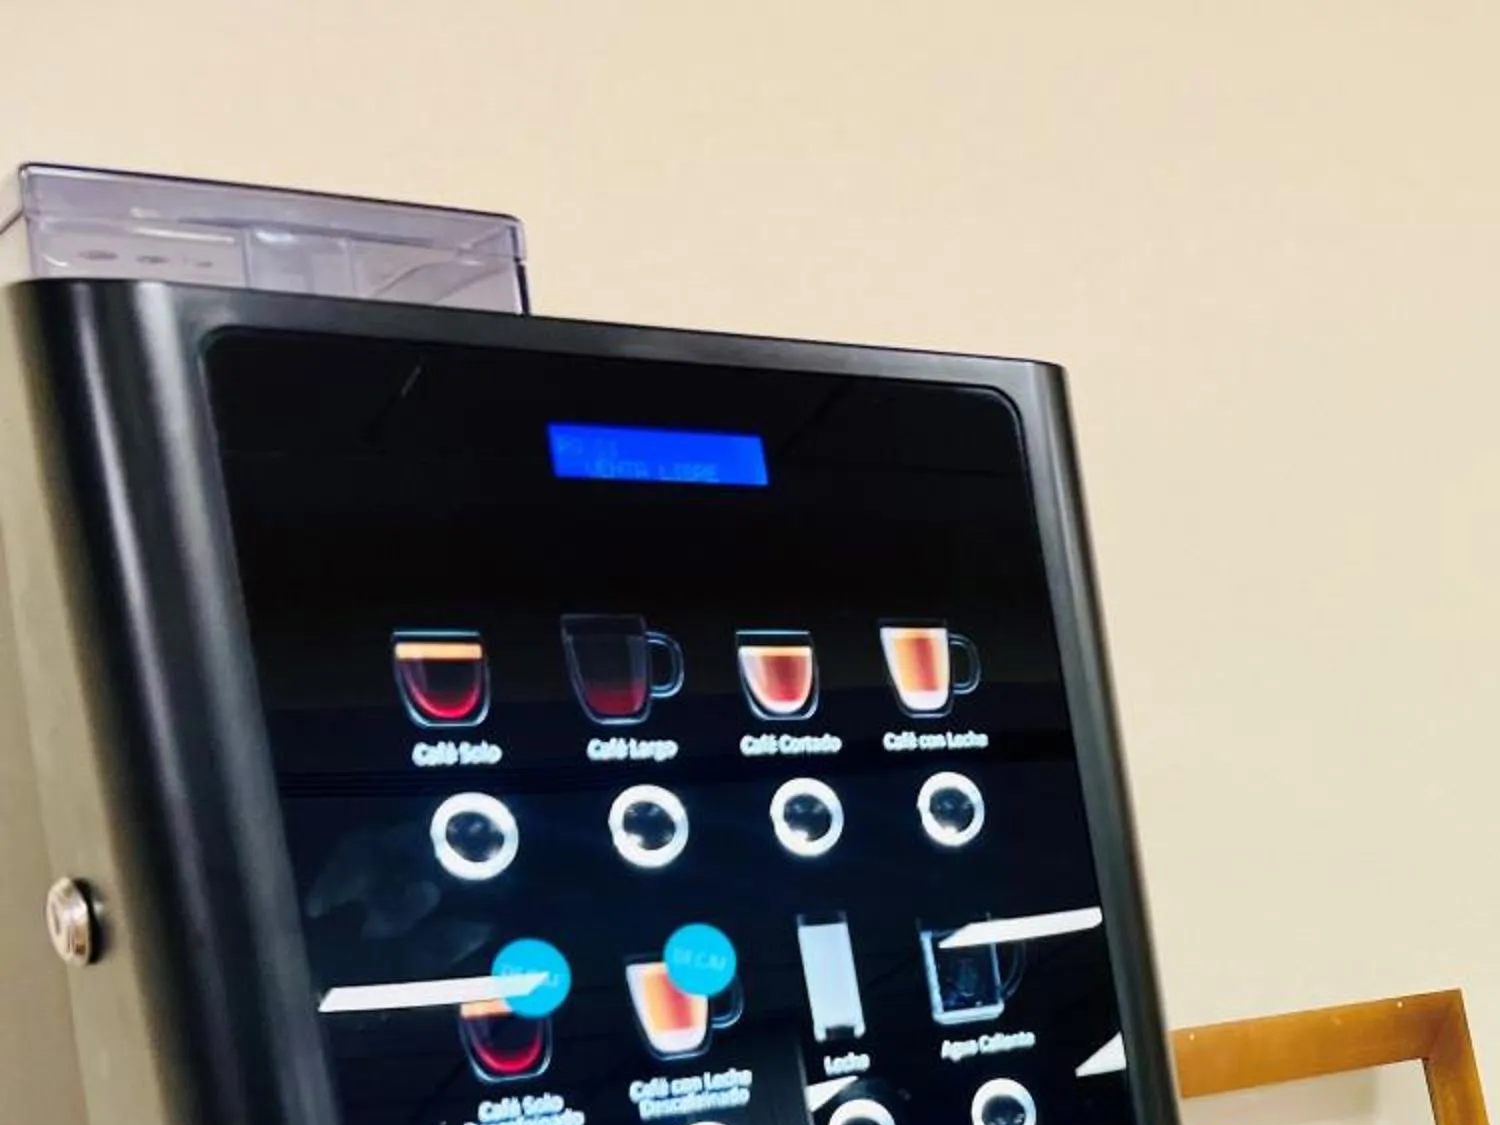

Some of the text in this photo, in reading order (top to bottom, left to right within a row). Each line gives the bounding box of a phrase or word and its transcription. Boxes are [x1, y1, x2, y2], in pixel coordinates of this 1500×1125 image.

[459, 740, 502, 764] Solo
[629, 738, 678, 763] Largo
[778, 733, 842, 755] Cortado
[919, 734, 945, 750] con
[946, 730, 988, 749] Leche
[941, 1031, 1036, 1062] Agua Caliente
[824, 1052, 870, 1076] Leche
[671, 1075, 703, 1098] con
[704, 1067, 752, 1092] Leche
[521, 1092, 564, 1115] Solo
